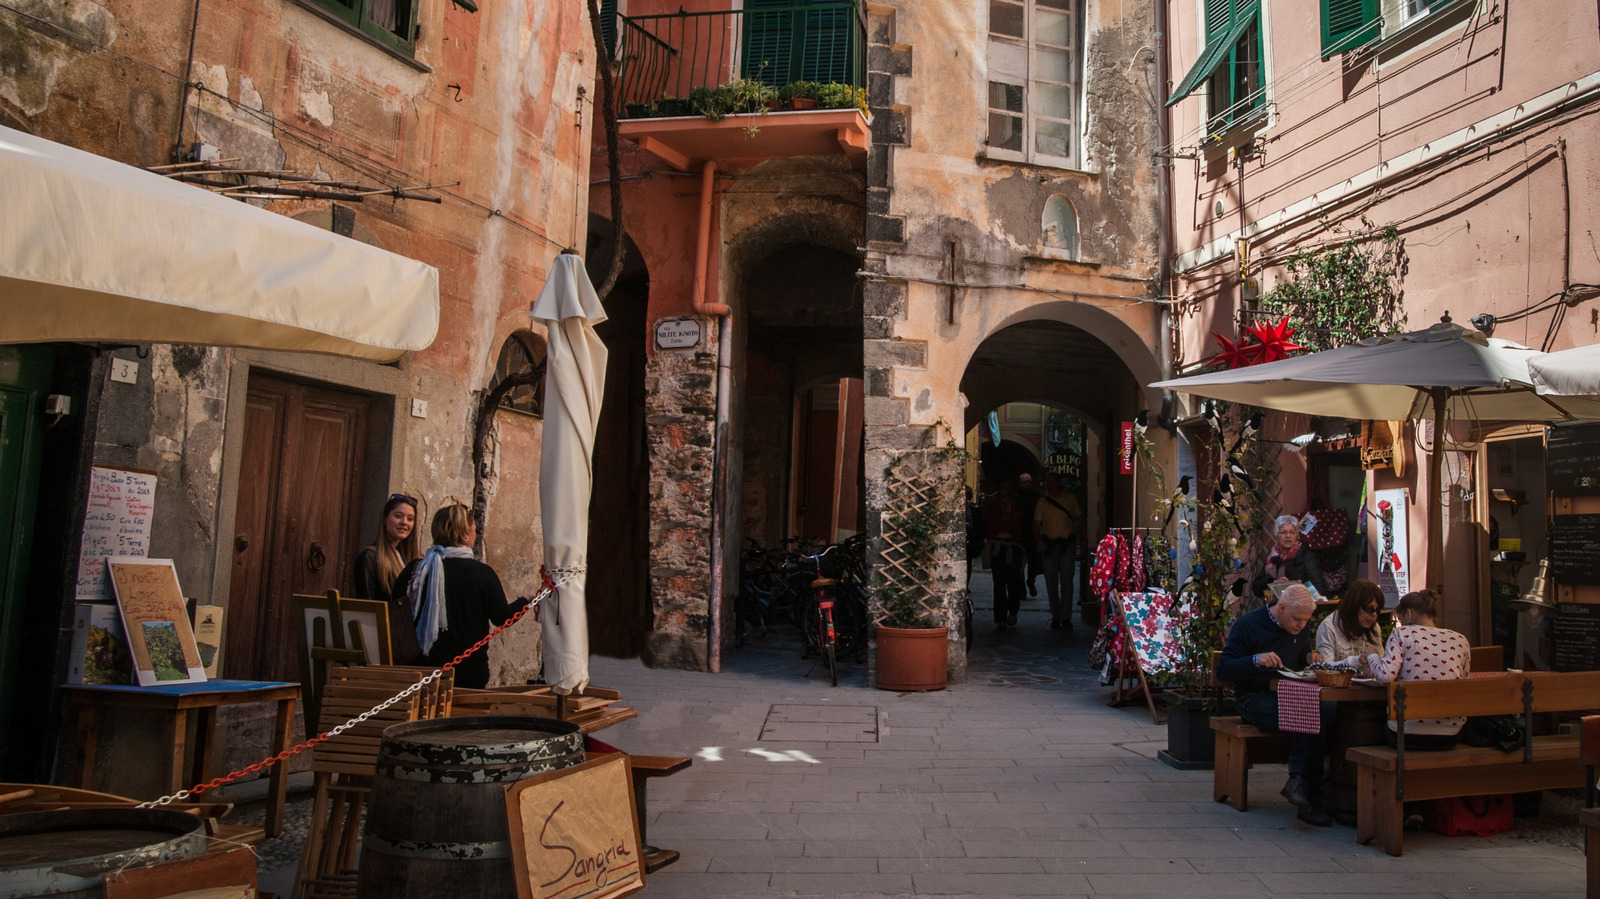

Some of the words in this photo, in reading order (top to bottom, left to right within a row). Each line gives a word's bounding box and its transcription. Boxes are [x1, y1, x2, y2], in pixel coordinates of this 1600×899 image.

[121, 364, 129, 378] 3
[417, 402, 423, 414] 4
[126, 476, 133, 485] 5
[119, 536, 126, 546] 5
[126, 537, 142, 547] Terre
[131, 572, 164, 584] nostri
[129, 586, 159, 599] Limoni
[1380, 586, 1406, 594] NECKLACE
[540, 799, 632, 889] Sangria
